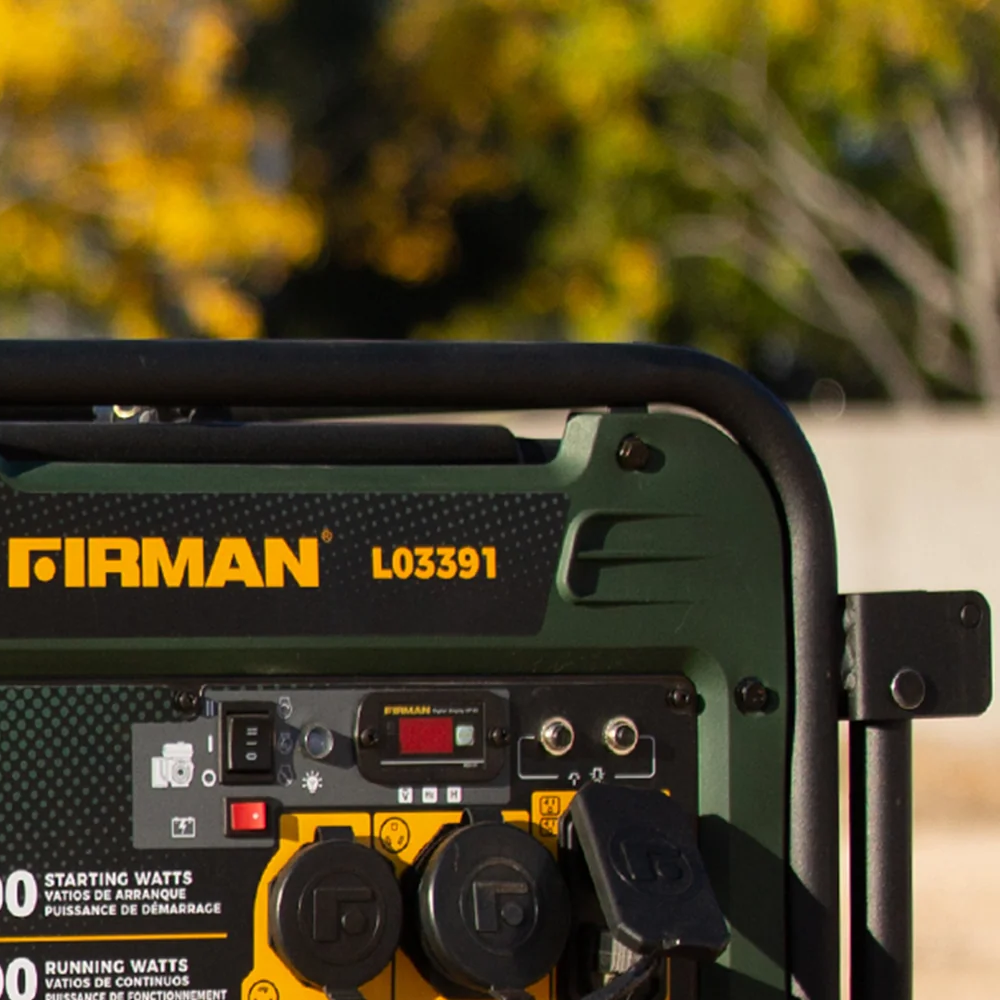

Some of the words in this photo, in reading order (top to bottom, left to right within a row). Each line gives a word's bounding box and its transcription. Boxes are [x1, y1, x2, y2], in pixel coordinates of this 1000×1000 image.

[8, 537, 320, 589] FIRMAN
[371, 546, 497, 579] L03391
[44, 872, 129, 887] STARTING
[134, 871, 193, 886] WATTS
[44, 889, 91, 901] VATIOS
[94, 889, 112, 900] DE
[115, 888, 187, 901] ARRANQUE
[44, 904, 117, 917] PUISSANCE
[120, 904, 138, 916] DE
[141, 901, 222, 915] DÉMARRAGE
[45, 960, 125, 975] RUNNING
[130, 958, 189, 973] WATTS
[44, 977, 91, 989] VATIOS
[94, 976, 112, 988] DE
[115, 975, 190, 987] CONTINUOS
